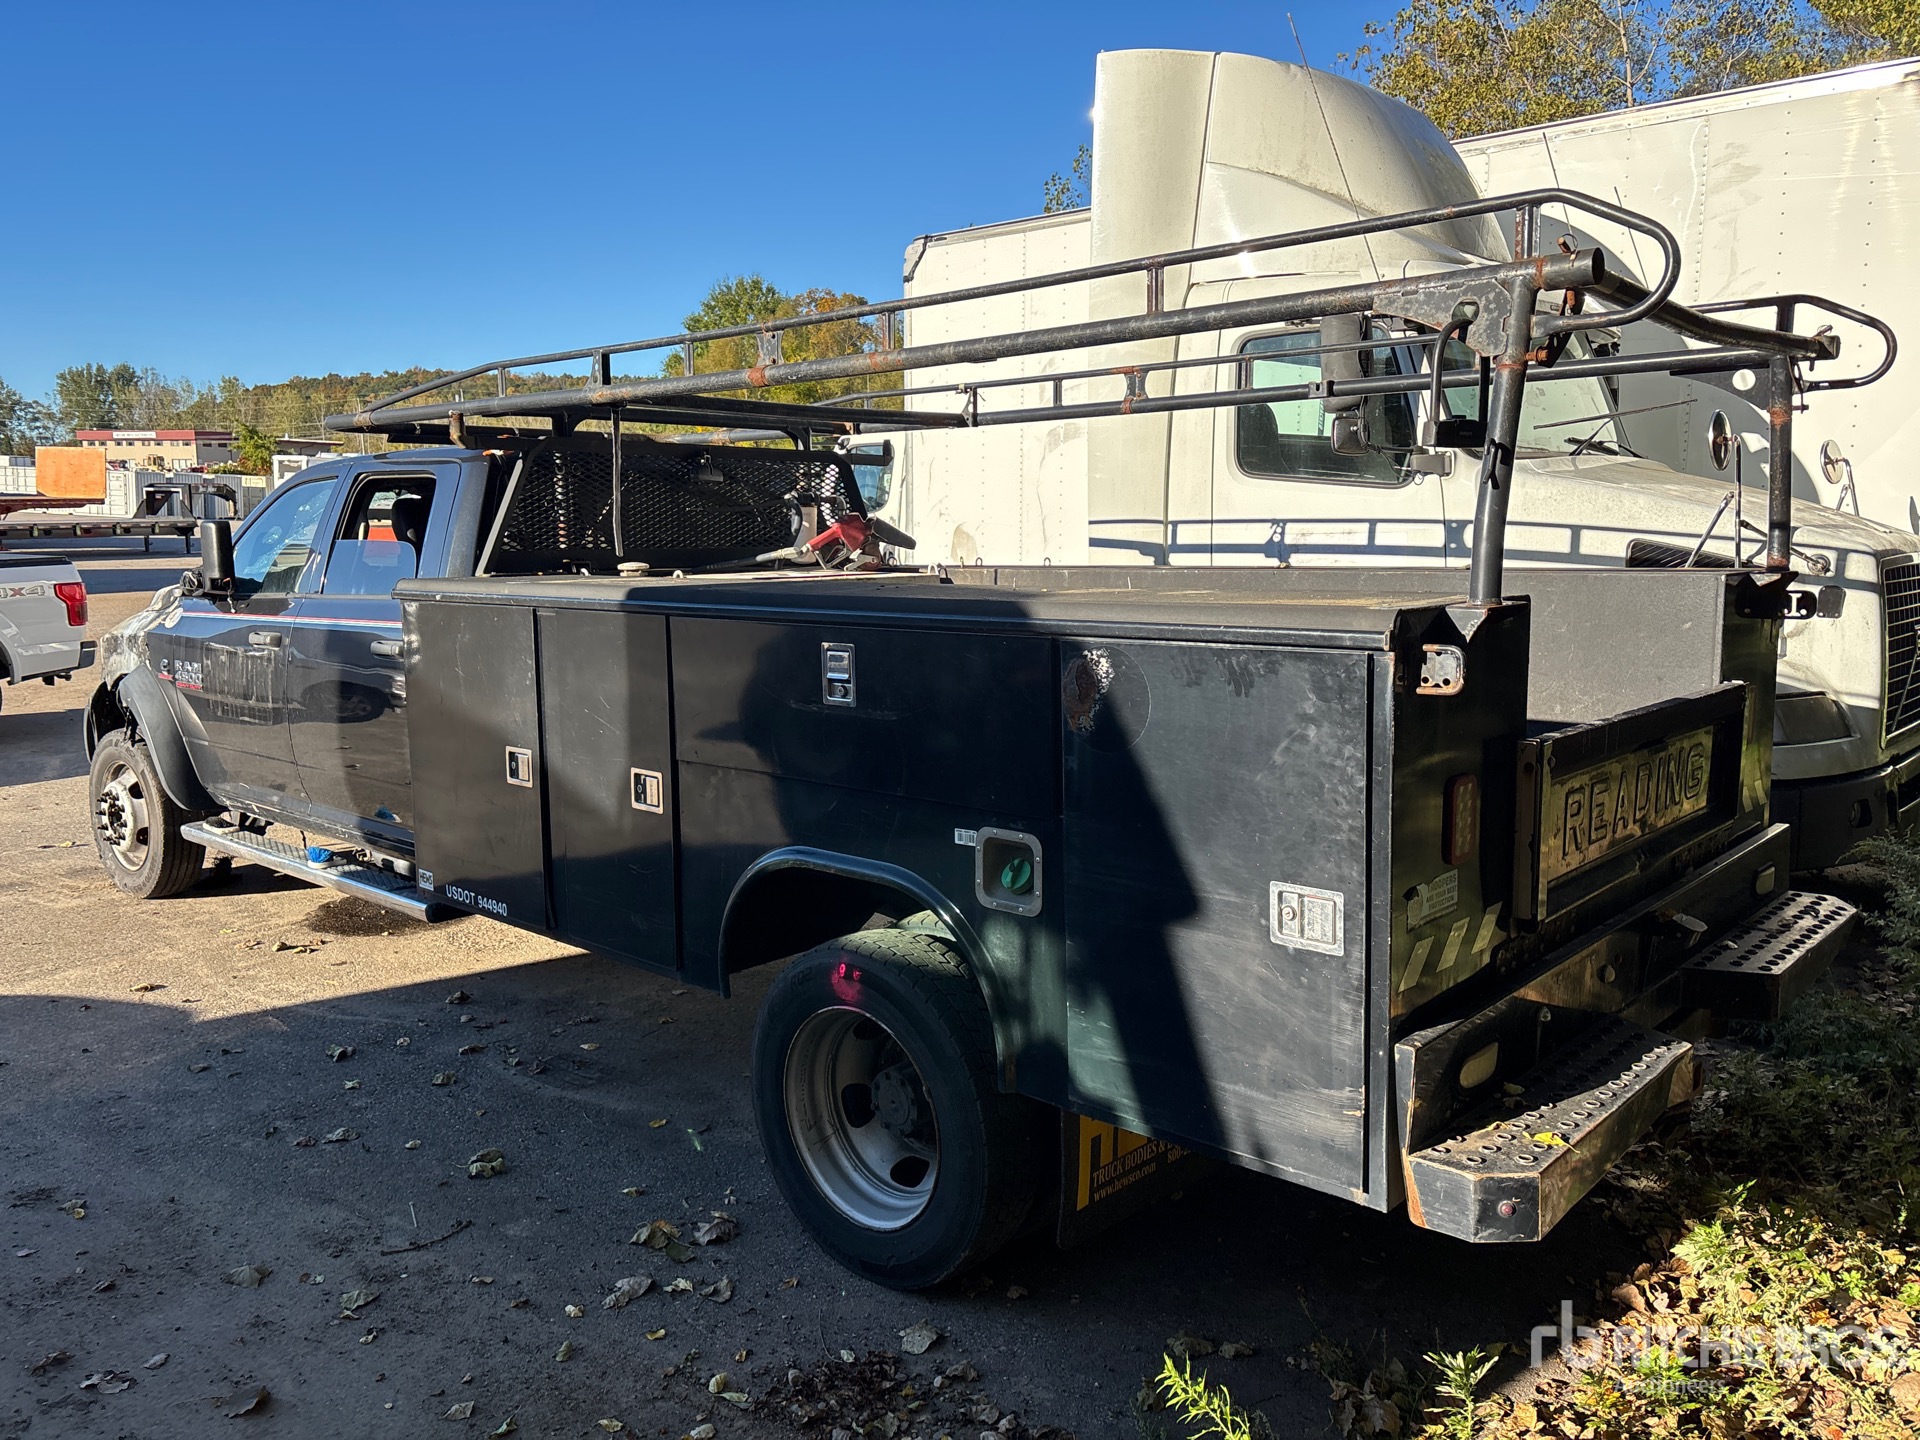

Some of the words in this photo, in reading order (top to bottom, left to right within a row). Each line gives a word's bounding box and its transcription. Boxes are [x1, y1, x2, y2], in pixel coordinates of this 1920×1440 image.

[174, 659, 202, 673] RAM
[175, 671, 203, 684] 4500
[1562, 742, 1705, 860] READING
[445, 884, 476, 905] USDOT
[477, 895, 508, 917] 944940
[1446, 885, 1457, 895] BEST
[1429, 894, 1455, 912] PROTECTION
[1092, 1157, 1125, 1188] TRUCK
[1125, 1140, 1157, 1171] BODIES
[1158, 1140, 1166, 1153] &
[1093, 1161, 1157, 1203] www.hewsco.com
